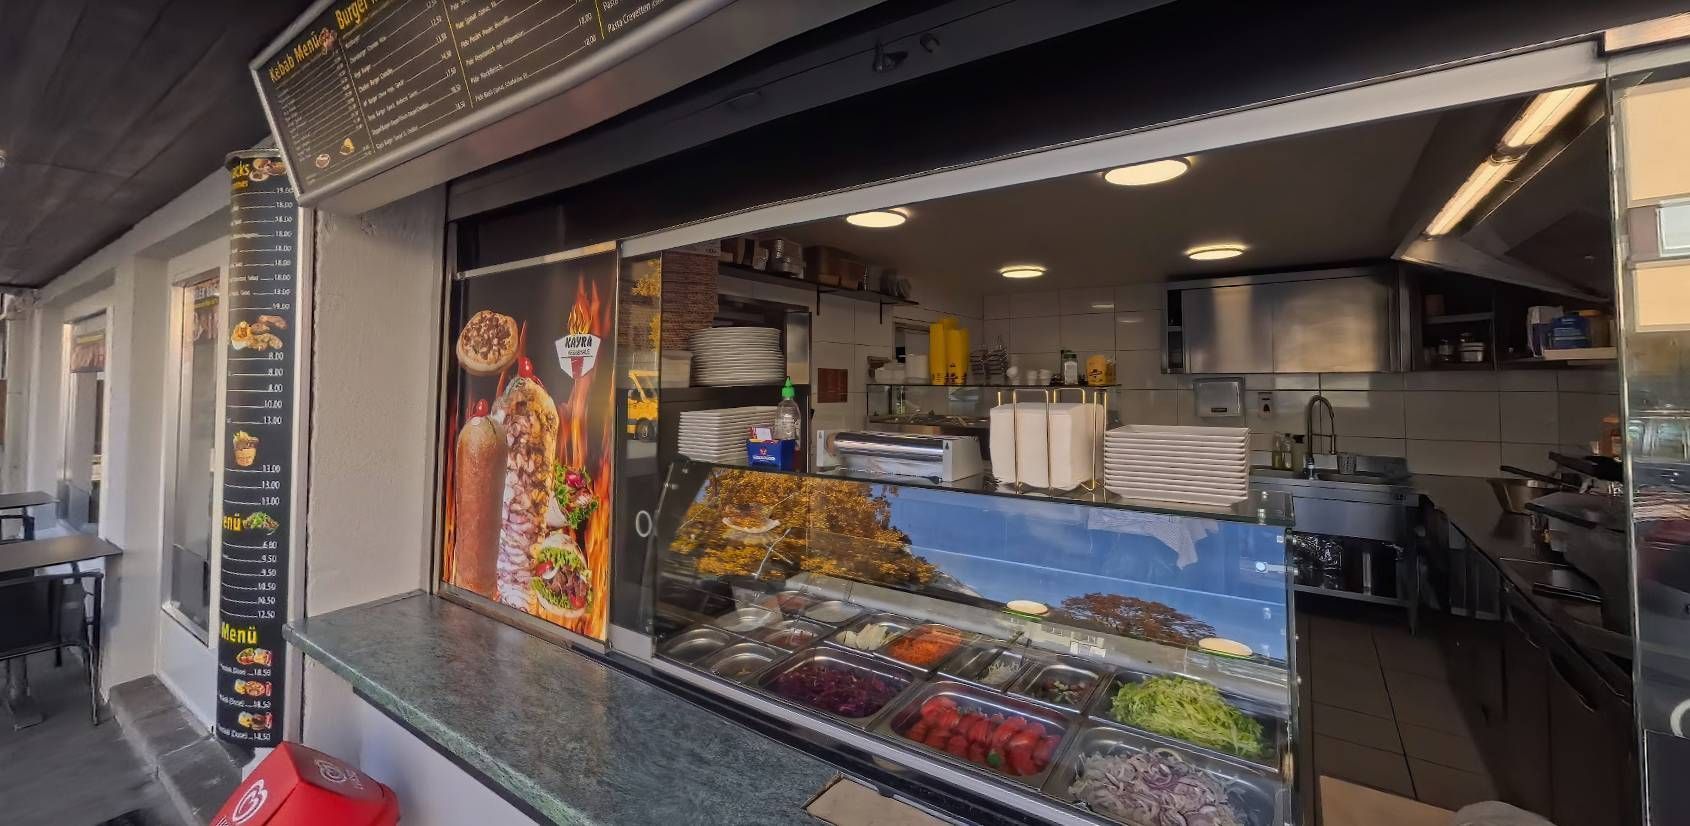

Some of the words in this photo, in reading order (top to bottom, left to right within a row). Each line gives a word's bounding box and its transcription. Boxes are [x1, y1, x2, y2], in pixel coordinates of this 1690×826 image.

[335, 0, 368, 30] Burger
[607, 19, 623, 33] Pasta
[623, 2, 651, 24] Crevetten
[269, 55, 295, 83] Kebab
[565, 336, 592, 348] KAYRA
[262, 480, 280, 489] 13.00
[261, 497, 280, 505] 13.00
[262, 555, 277, 563] 9.50
[258, 610, 275, 618] 12.50
[221, 621, 257, 644] Menü
